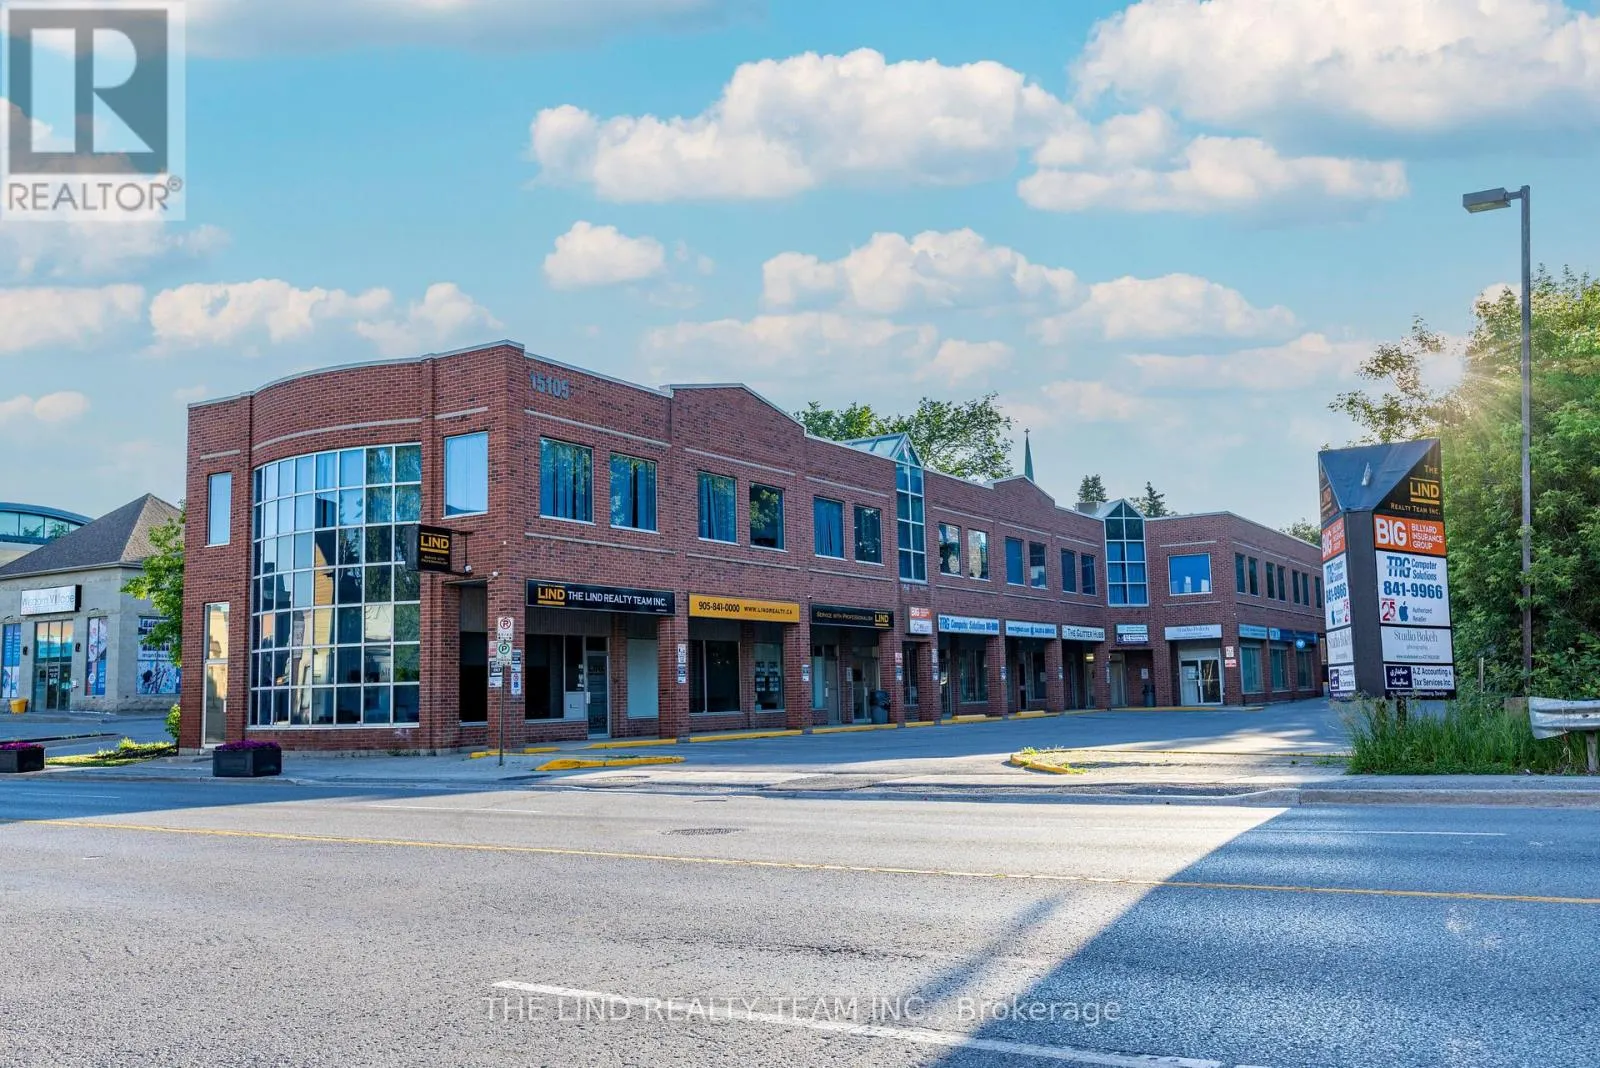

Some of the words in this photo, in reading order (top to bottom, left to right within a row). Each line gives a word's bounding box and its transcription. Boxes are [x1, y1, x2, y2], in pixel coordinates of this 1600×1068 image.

[530, 370, 569, 400] 15105
[1424, 465, 1439, 474] THE
[1410, 481, 1440, 498] LIND
[1375, 518, 1407, 547] BIG
[1411, 523, 1437, 534] BILLYARD
[421, 535, 450, 549] LIND
[1411, 532, 1443, 543] INSURANCE
[1412, 541, 1433, 550] GROUP
[1386, 555, 1411, 578] TRG
[1411, 558, 1437, 570] Computer
[1412, 570, 1437, 581] Solutions
[1384, 580, 1443, 599] 841-9966
[537, 587, 566, 600] LIND
[567, 591, 584, 601] THE
[584, 592, 603, 602] LIND
[603, 594, 632, 605] REALTY
[633, 596, 653, 606] TEAM
[653, 597, 668, 607] INC.
[698, 601, 740, 612] 905-841-0000
[874, 614, 889, 623] LIND
[1394, 630, 1416, 642] Studio
[1417, 630, 1438, 642] Bokeh
[1421, 668, 1448, 677] Accounting
[1422, 679, 1443, 687] Services
